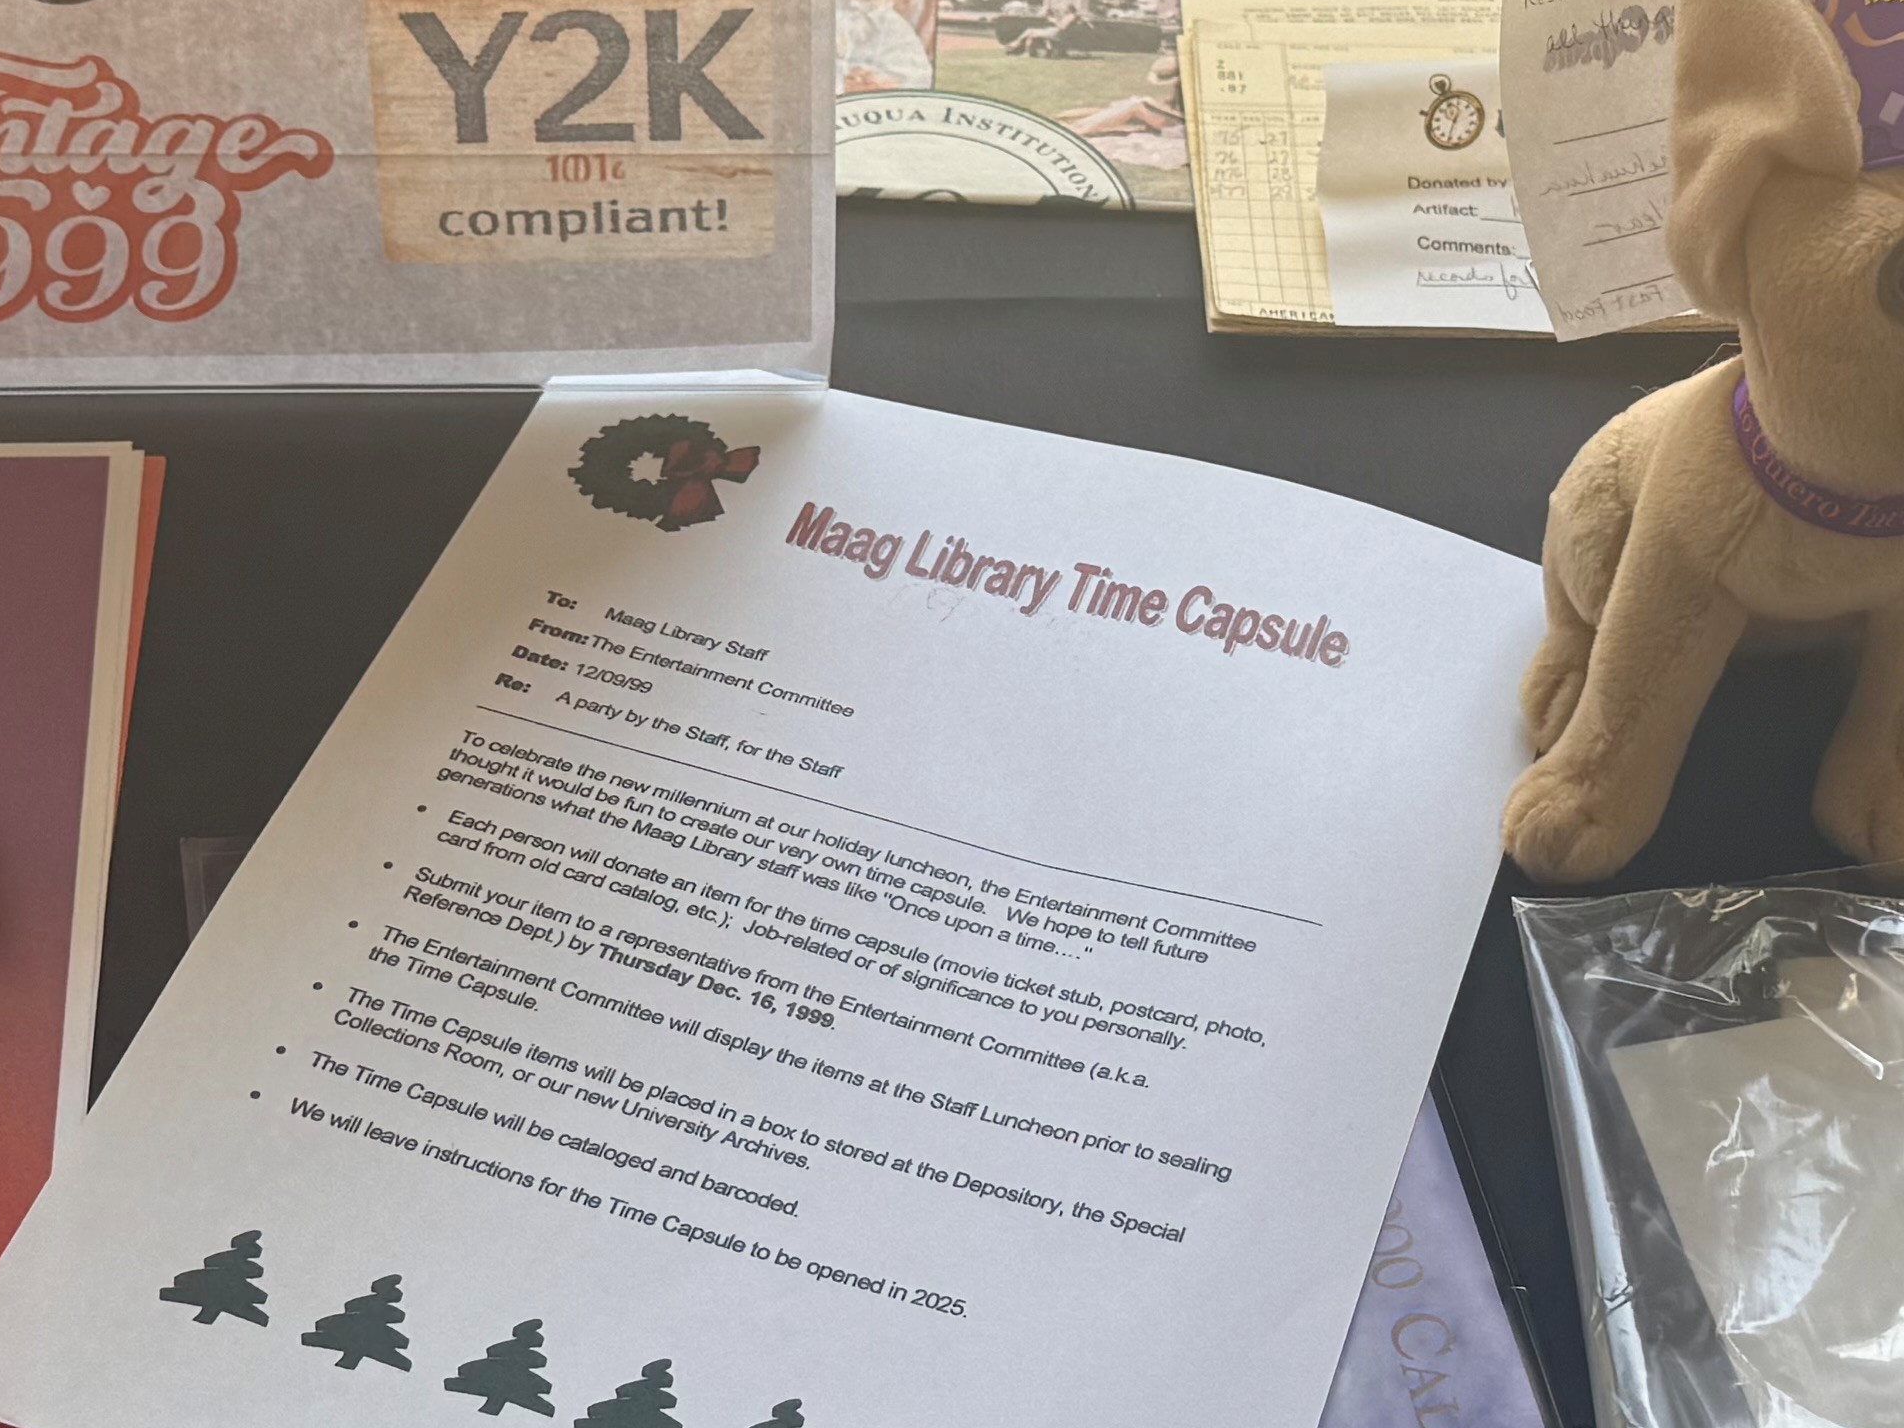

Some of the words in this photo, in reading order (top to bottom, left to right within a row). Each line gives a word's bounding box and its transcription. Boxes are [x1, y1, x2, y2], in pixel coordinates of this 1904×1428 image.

[398, 8, 758, 144] Y2K
[438, 198, 727, 242] compliant!
[547, 590, 577, 610] To:
[604, 607, 656, 634] Maag
[659, 622, 722, 651] Library
[725, 640, 770, 661] Staff
[786, 501, 901, 574] Maag
[905, 533, 1060, 607] Library
[1068, 562, 1167, 625] Time
[1175, 587, 1347, 667] Capsule
[512, 645, 569, 671] Date:
[577, 663, 653, 693] 12/09/99
[528, 618, 589, 645] From:
[592, 634, 625, 655] The
[628, 646, 753, 690] Entertainment
[757, 681, 854, 716] Committee
